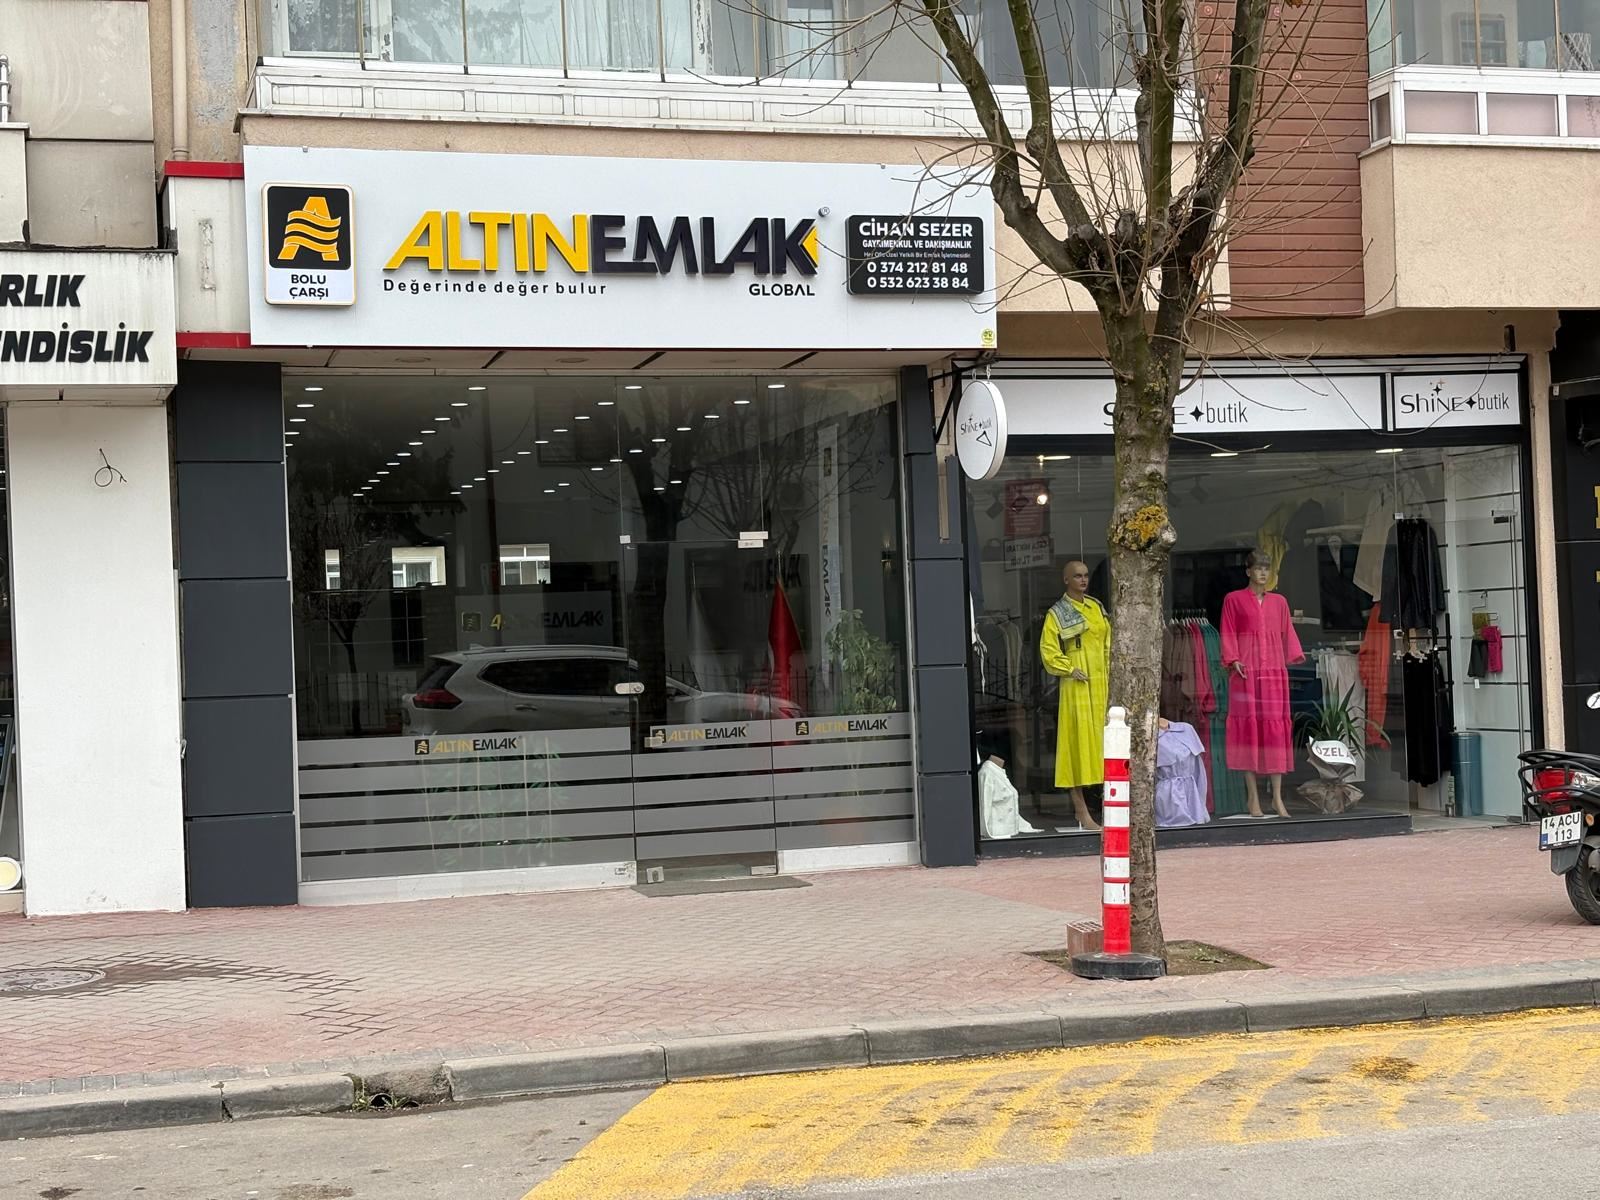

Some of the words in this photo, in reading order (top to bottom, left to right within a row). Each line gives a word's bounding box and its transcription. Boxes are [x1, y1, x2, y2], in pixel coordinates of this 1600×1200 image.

[859, 217, 914, 236] CİHAN
[919, 223, 973, 237] SEZER
[383, 210, 818, 276] ALTINEMLAK
[914, 240, 924, 249] VE
[924, 240, 972, 251] DANIŞMANLIK
[867, 262, 877, 273] 0
[880, 262, 903, 273] 374
[906, 262, 928, 273] 212
[931, 262, 946, 273] 81
[950, 262, 968, 273] 48
[291, 274, 327, 284] BOLU
[867, 277, 877, 288] 0
[879, 277, 903, 288] 532
[906, 277, 930, 288] 623
[932, 277, 949, 288] 38
[952, 277, 969, 289] 84
[289, 286, 329, 301] ÇARŞI
[383, 279, 487, 294] Değerinde
[494, 280, 549, 296] değer
[555, 282, 607, 295] bulur
[750, 283, 816, 296] GLOBAL
[0, 322, 154, 364] NDİSLİK
[1477, 392, 1510, 410] butik
[1206, 401, 1249, 424] butik
[1544, 817, 1555, 829] 14
[1558, 812, 1580, 827] ACU
[1555, 829, 1572, 841] 113
